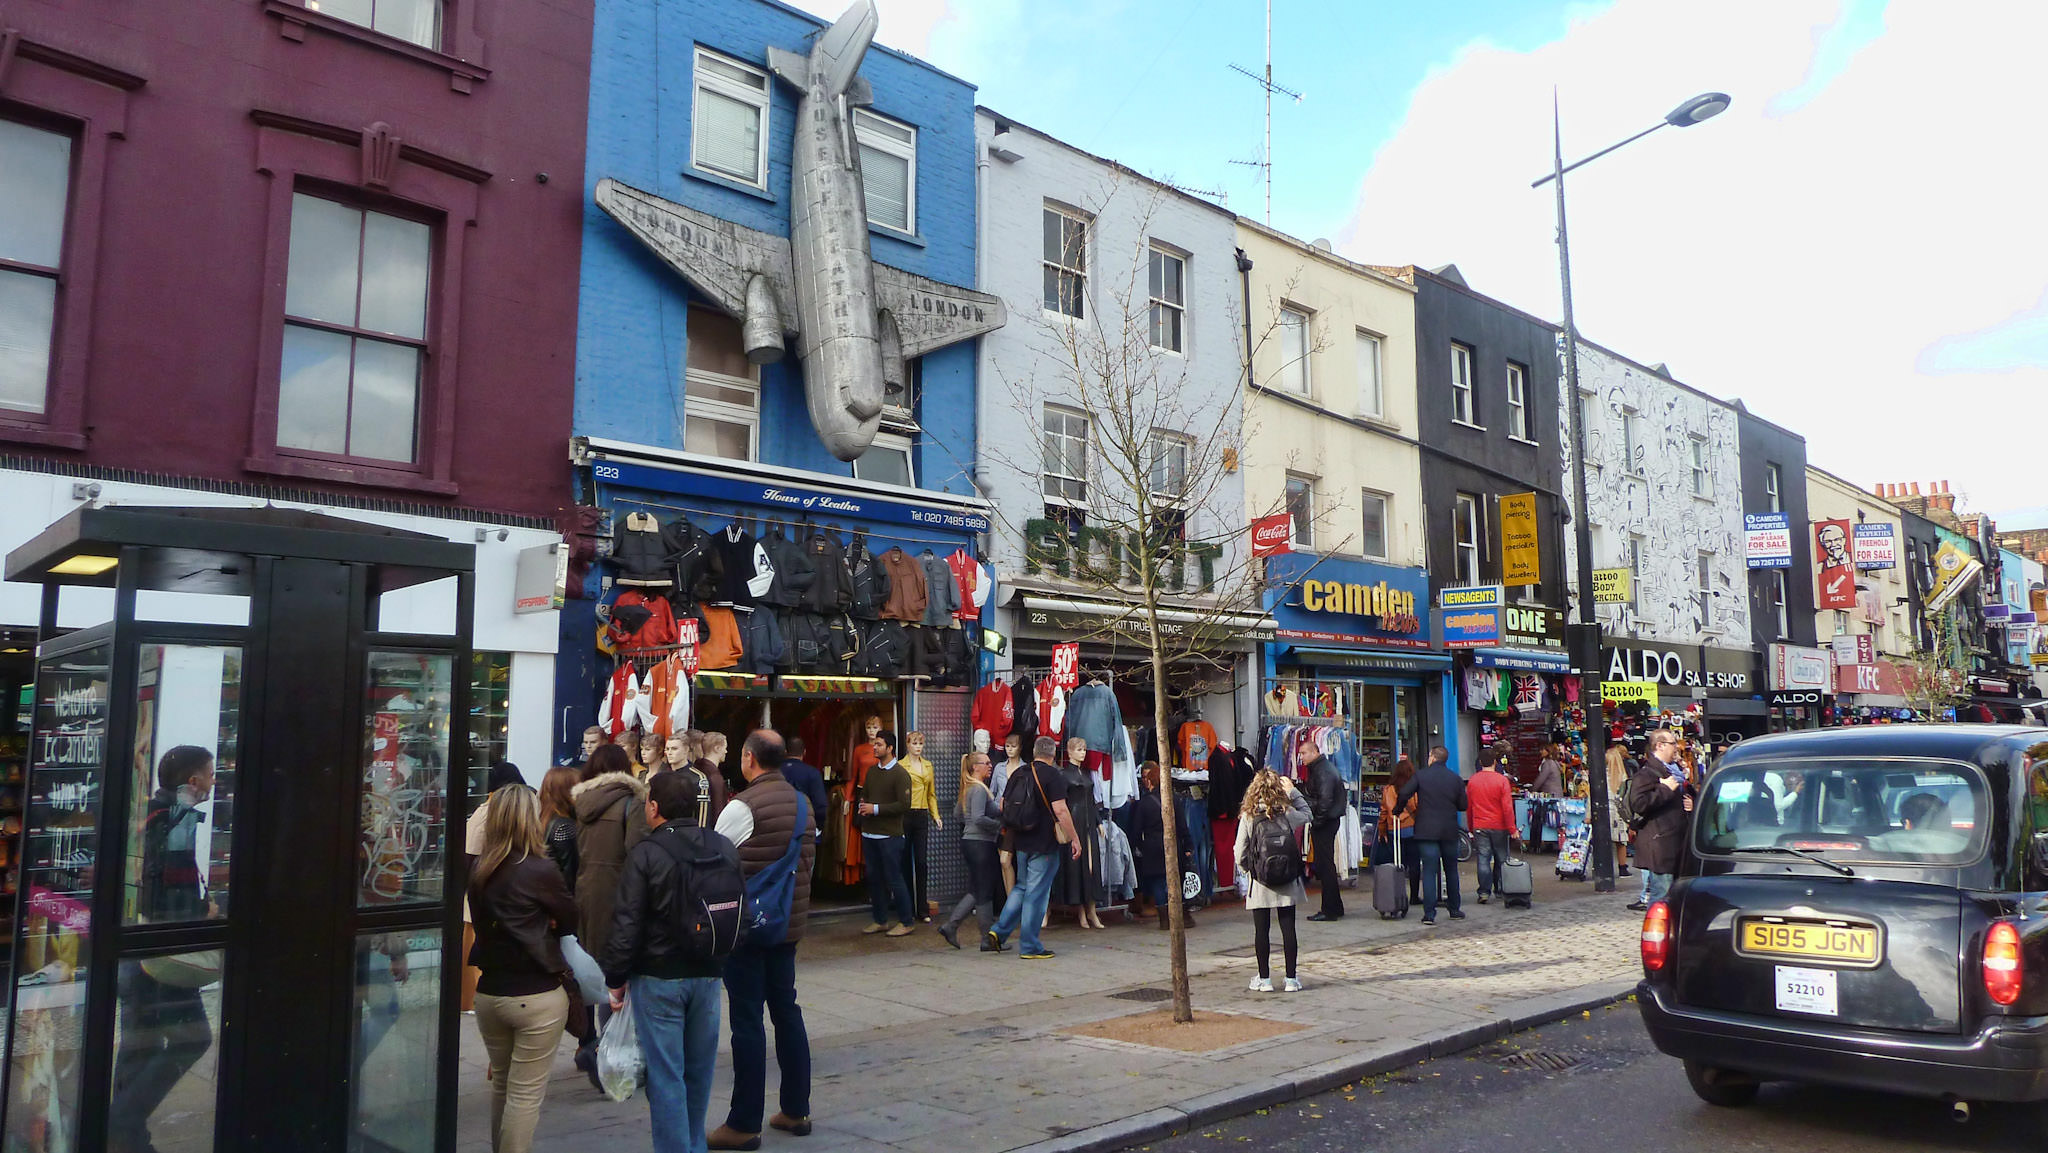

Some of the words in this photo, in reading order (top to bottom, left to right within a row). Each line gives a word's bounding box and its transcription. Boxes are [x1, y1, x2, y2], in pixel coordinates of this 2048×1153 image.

[827, 217, 849, 356] LEATHE
[910, 293, 984, 323] LONDON
[595, 465, 619, 479] 223
[762, 488, 800, 503] House
[803, 496, 818, 508] of
[818, 496, 860, 512] Leather
[924, 512, 941, 524] 020
[943, 514, 964, 527] 7485
[965, 517, 987, 529] 5899
[1766, 540, 1788, 548] SALE
[1859, 539, 1889, 547] FREEHOLD
[1856, 550, 1872, 559] FOR
[1873, 550, 1892, 559] SALE
[1593, 572, 1618, 581] attoo
[1303, 579, 1414, 618] camden
[1444, 590, 1496, 605] NEWSAGENTS
[1595, 593, 1625, 602] ERCING
[1031, 613, 1048, 624] 225
[1378, 612, 1420, 633] news
[1445, 613, 1495, 628] camden
[1128, 620, 1150, 632] TRUE
[1158, 624, 1184, 635] NTAGE
[1053, 647, 1078, 674] 50%
[1607, 646, 1683, 685] ALDO
[1685, 670, 1715, 687] SAE
[1716, 673, 1746, 688] SHOP
[1055, 672, 1075, 684] OFF
[1857, 665, 1880, 691] KFC
[1601, 684, 1643, 697] tattoo
[1772, 693, 1818, 704] ALDO
[1754, 927, 1807, 949] S195
[1815, 931, 1865, 953] JGN
[1787, 983, 1825, 997] 52210
